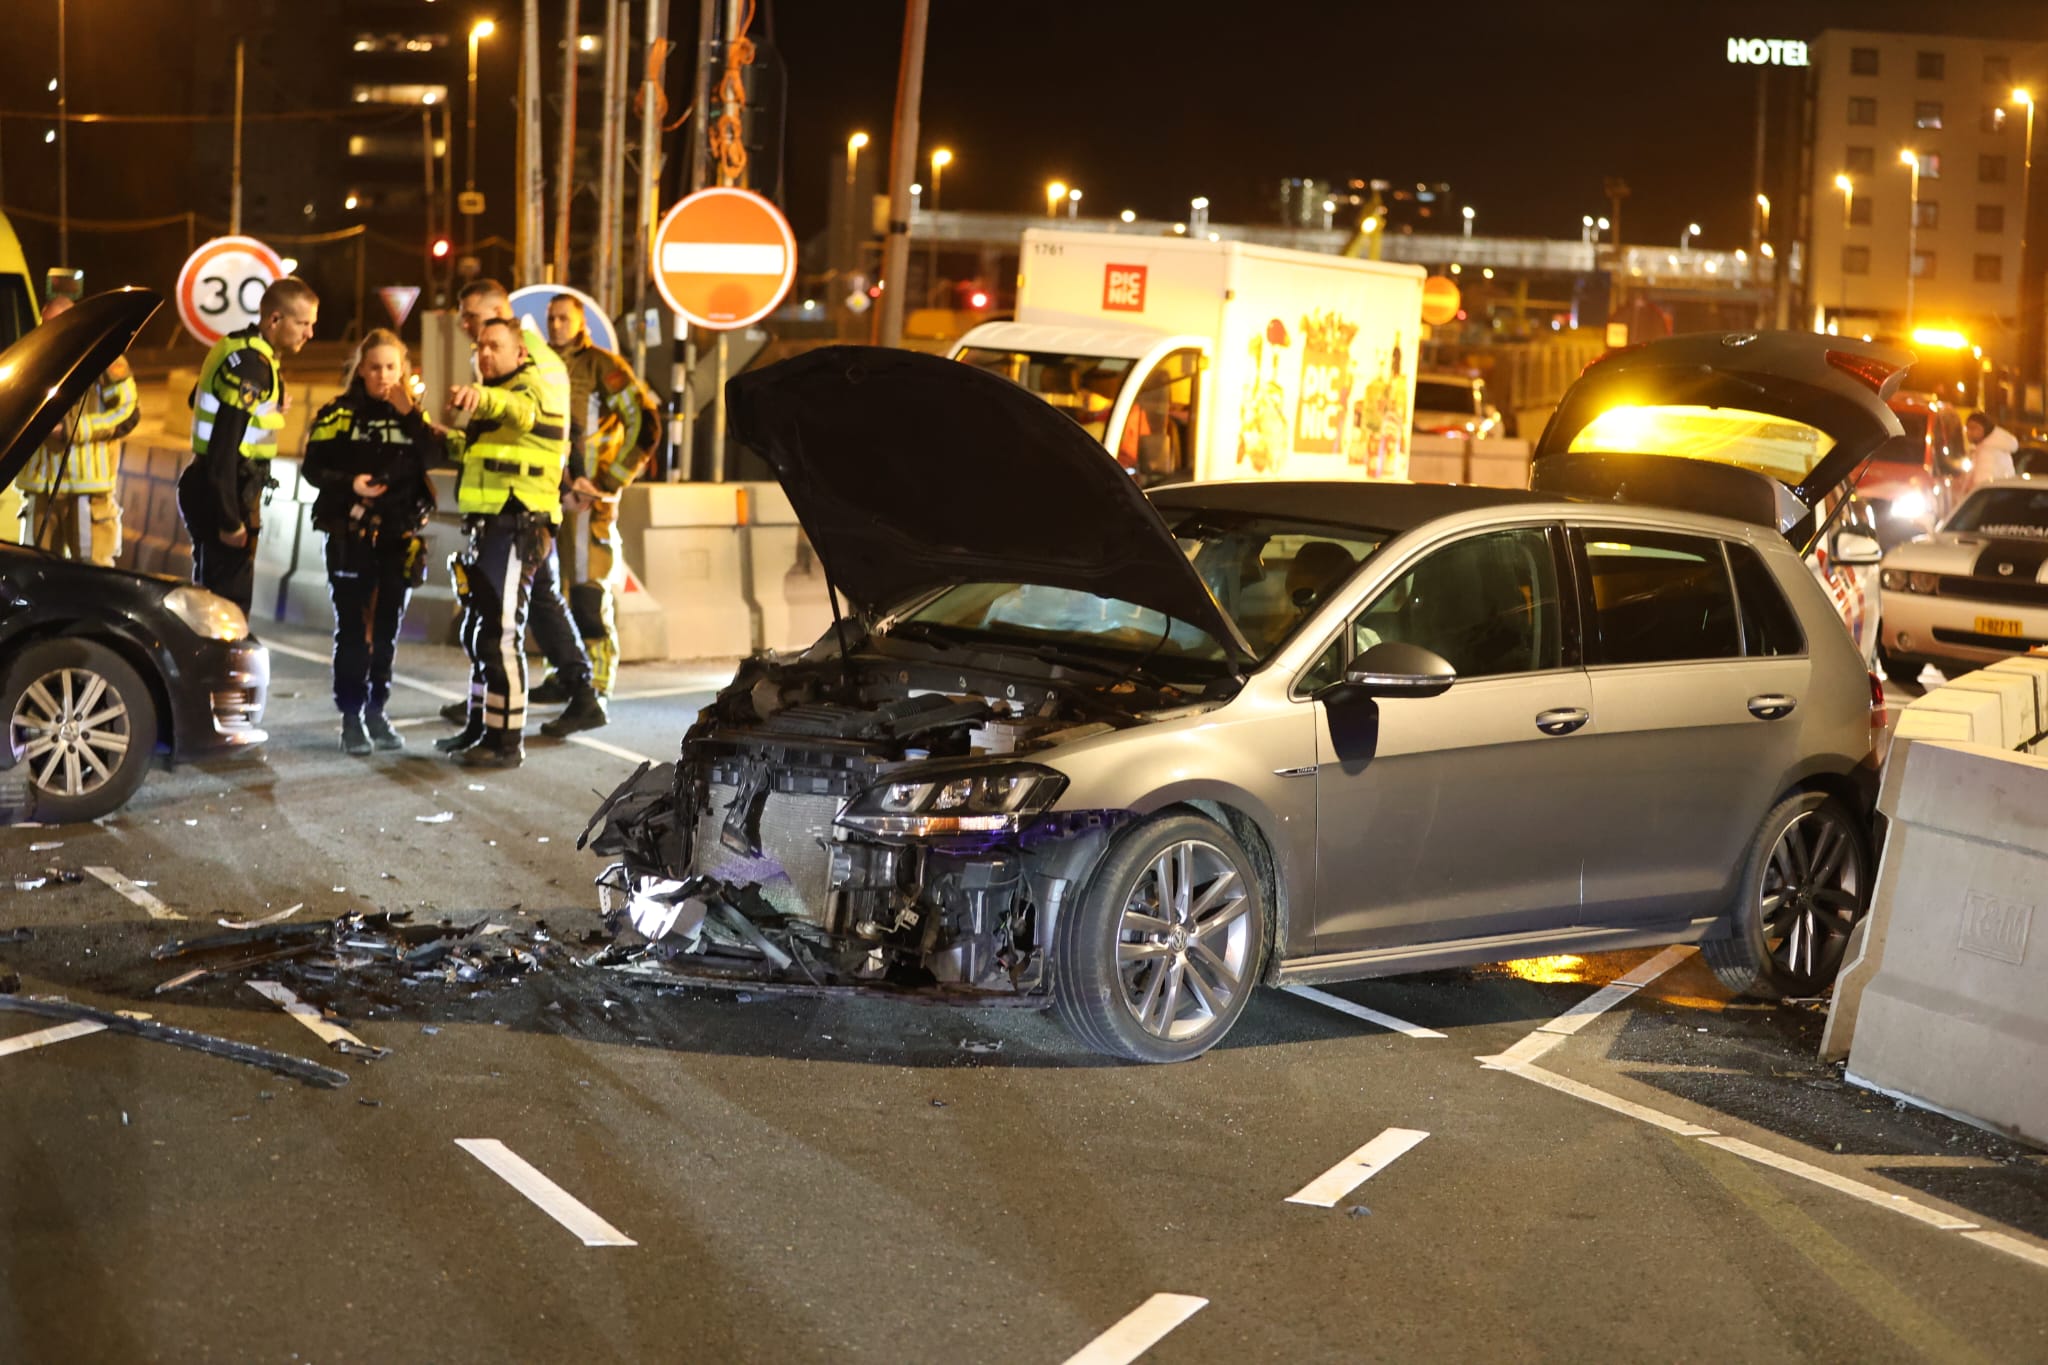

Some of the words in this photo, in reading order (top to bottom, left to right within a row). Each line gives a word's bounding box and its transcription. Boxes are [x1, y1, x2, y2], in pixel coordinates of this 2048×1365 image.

[1727, 37, 1810, 66] HOTEL
[1035, 243, 1064, 256] 1761
[1109, 271, 1141, 289] PIC
[199, 276, 268, 315] 30
[1303, 365, 1341, 401] PIC
